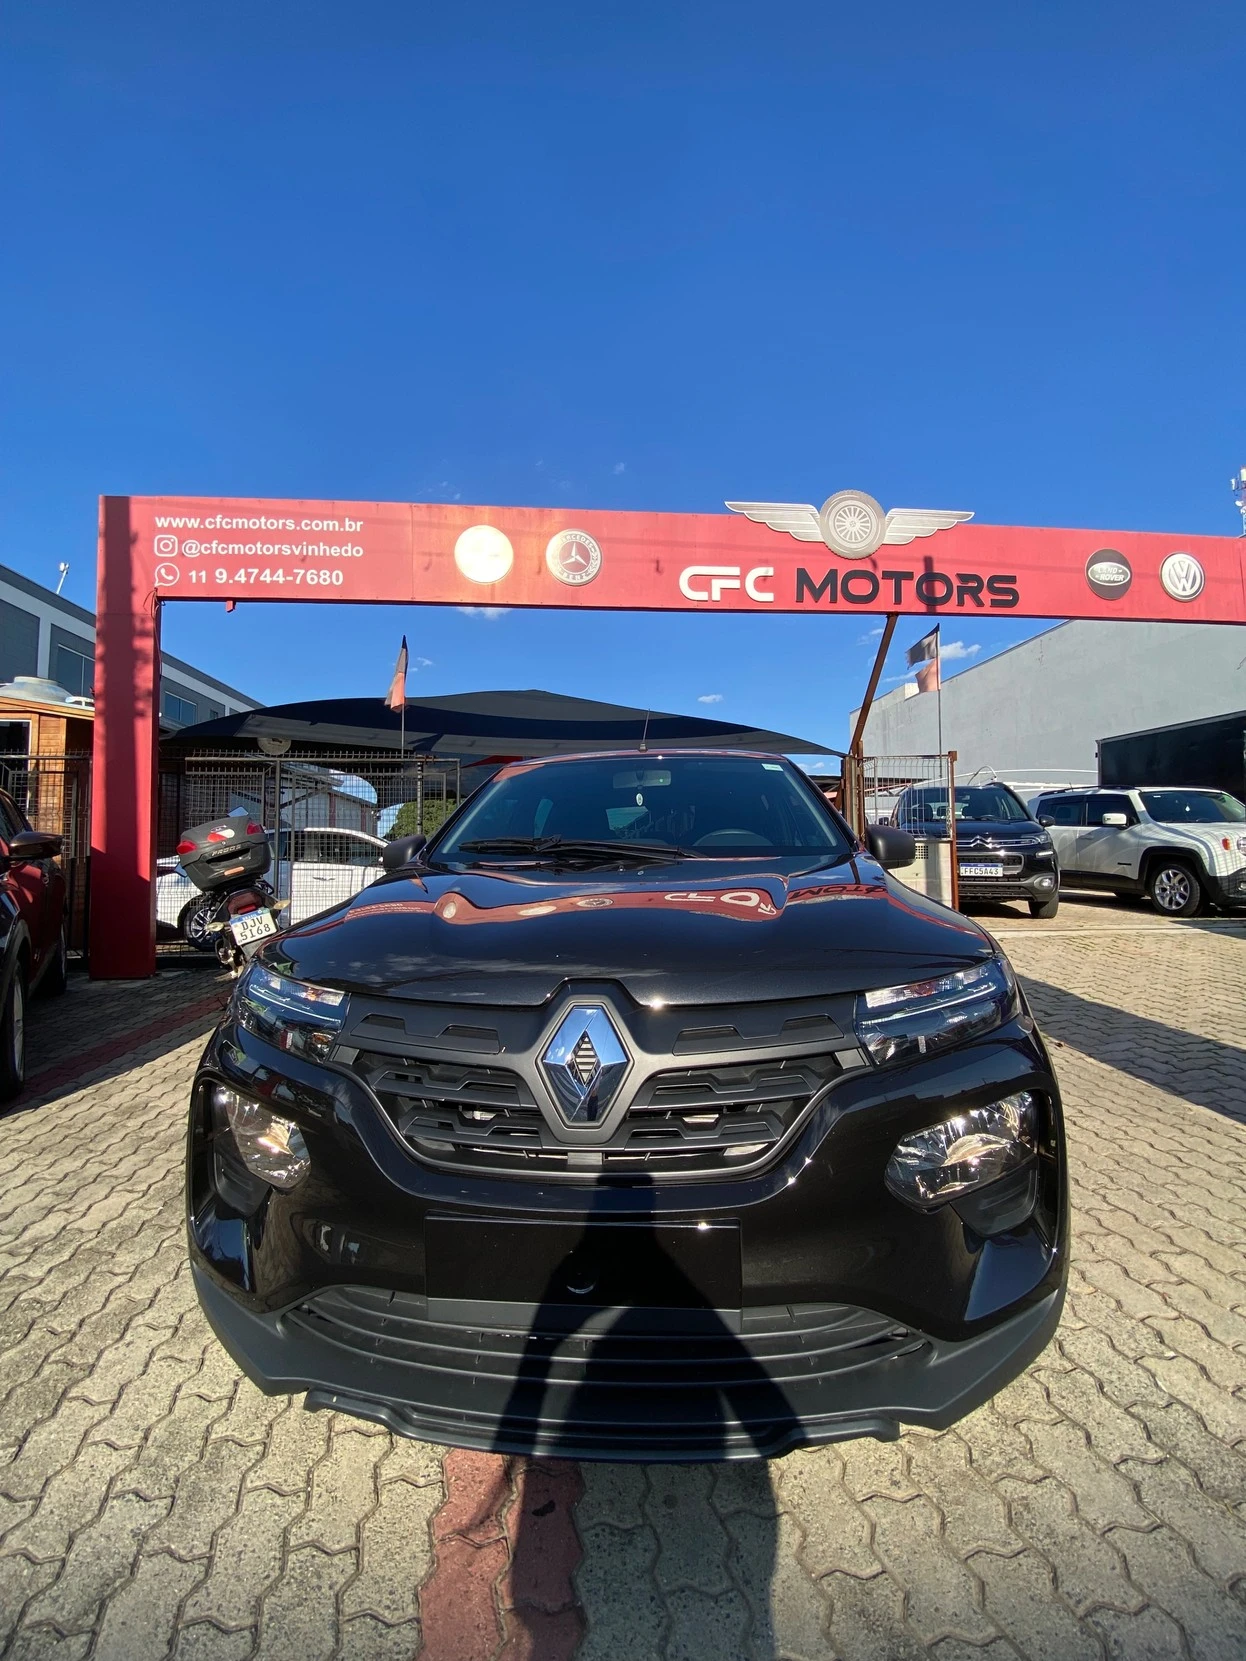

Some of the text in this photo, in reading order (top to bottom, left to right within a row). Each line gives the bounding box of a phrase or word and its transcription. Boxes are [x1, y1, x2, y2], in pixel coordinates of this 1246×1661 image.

[155, 514, 364, 532] www.cfcmotors.com.br
[181, 539, 364, 558] @cfcmotorsvinhedo
[188, 568, 344, 585] 11 9.4744-7680
[1099, 574, 1125, 582] ROVER
[678, 565, 1020, 608] CFC MOTORS
[241, 916, 263, 930] DJV
